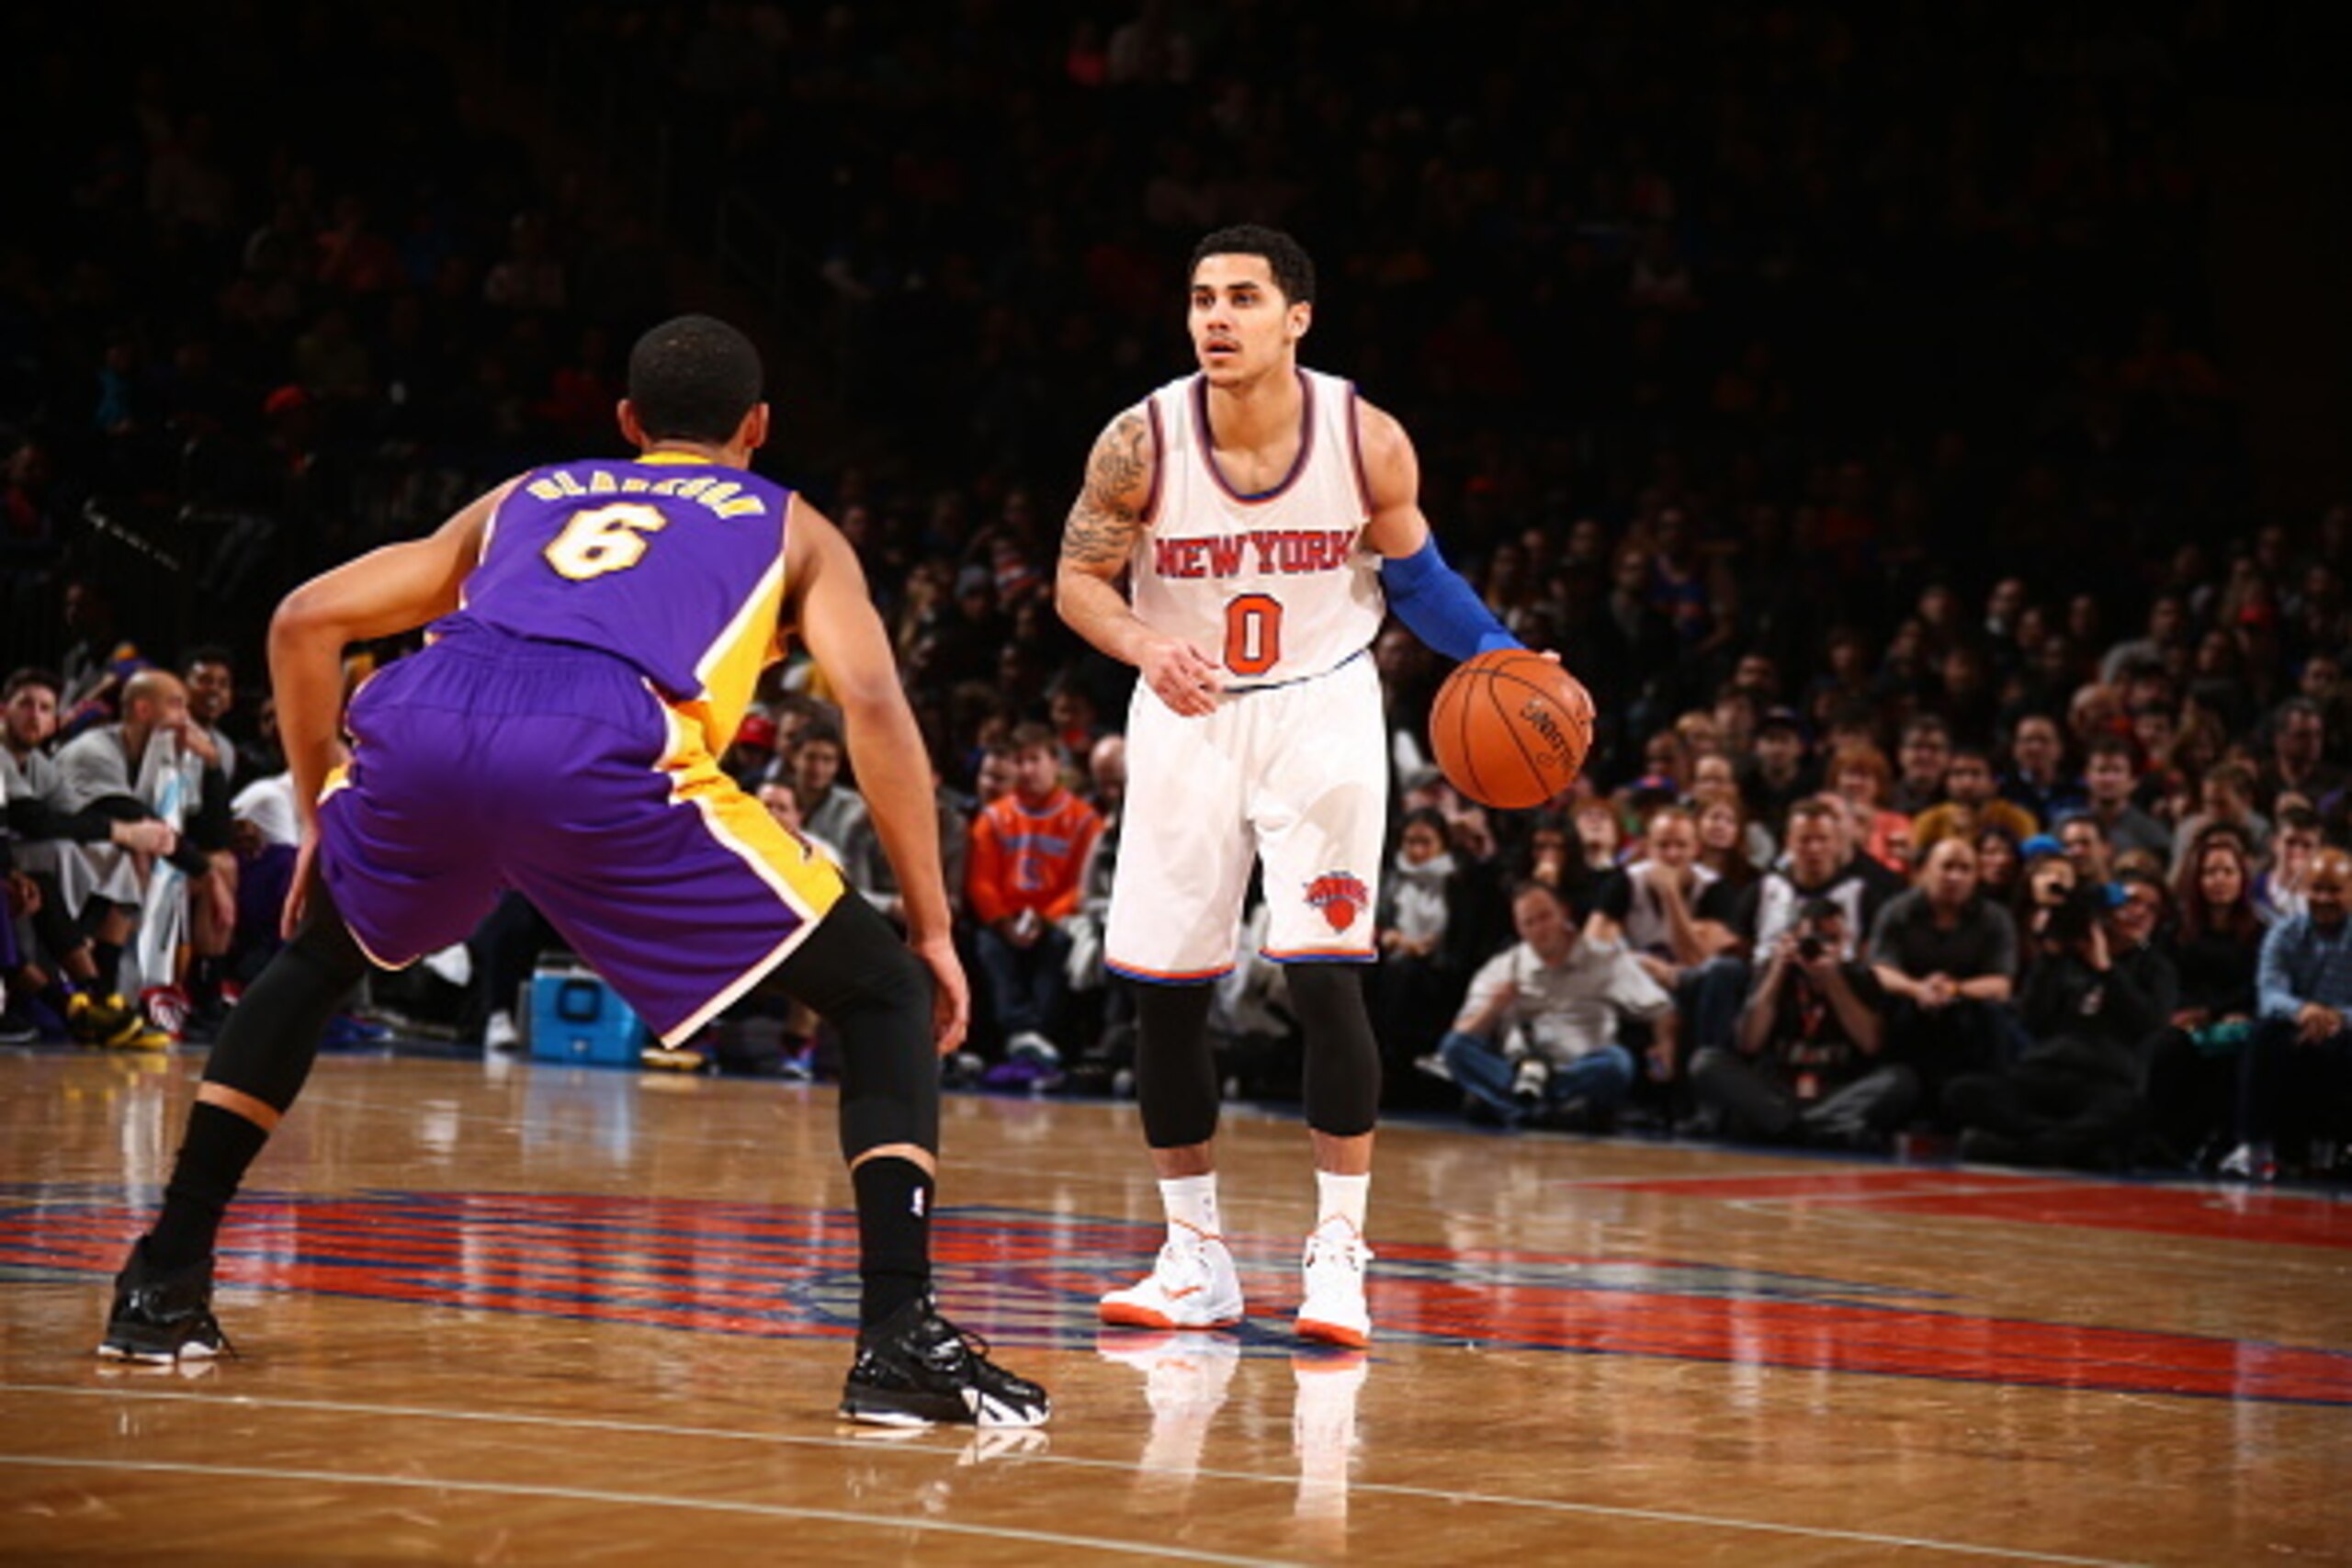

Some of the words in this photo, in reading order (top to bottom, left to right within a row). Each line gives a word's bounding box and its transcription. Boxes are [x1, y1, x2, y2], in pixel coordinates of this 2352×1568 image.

[544, 502, 668, 581] 6
[1155, 535, 1247, 579] NEW
[1250, 529, 1356, 574] YORK
[1224, 593, 1283, 677] 0
